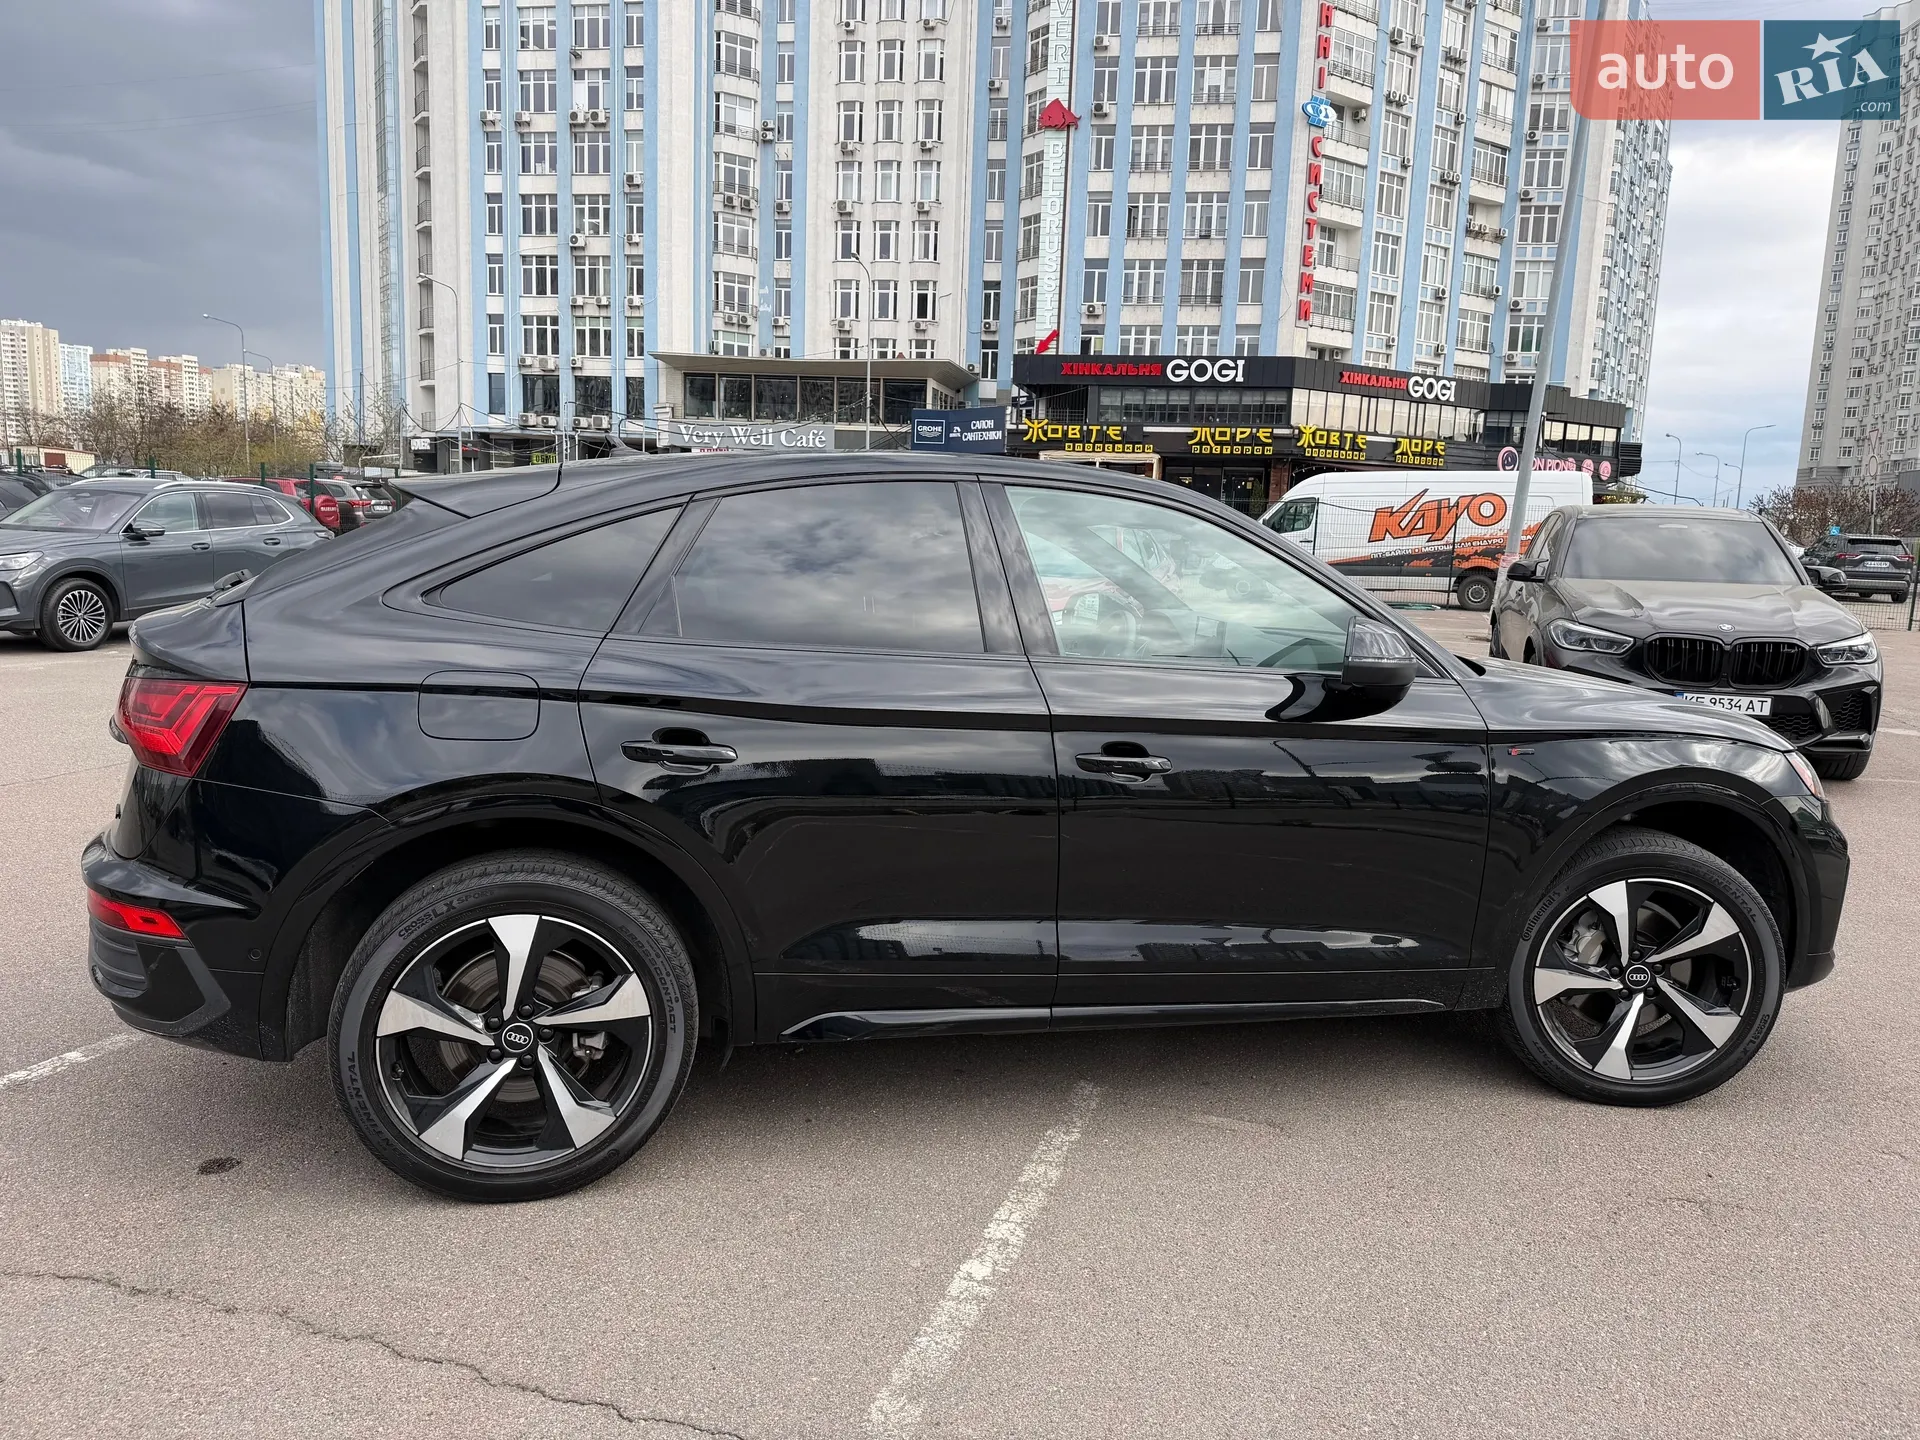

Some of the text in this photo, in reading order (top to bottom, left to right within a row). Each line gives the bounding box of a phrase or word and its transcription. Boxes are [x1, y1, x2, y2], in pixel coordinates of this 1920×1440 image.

[1298, 136, 1322, 321] СИСТЕМИ
[1061, 359, 1245, 382] ХІНКАЛЬНЯ GOGI
[1340, 371, 1456, 402] ХІНКАЛЬНЯ GOGI
[971, 419, 994, 429] САЛОН
[678, 424, 827, 448] Very Well Café
[962, 431, 1002, 441] САНТЕХНІКИ
[1368, 488, 1507, 543] KAYO
[1370, 548, 1412, 559] ПІТ-БАЙКИ
[1472, 537, 1504, 548] ЕНДУРО
[1745, 700, 1768, 712] AT
